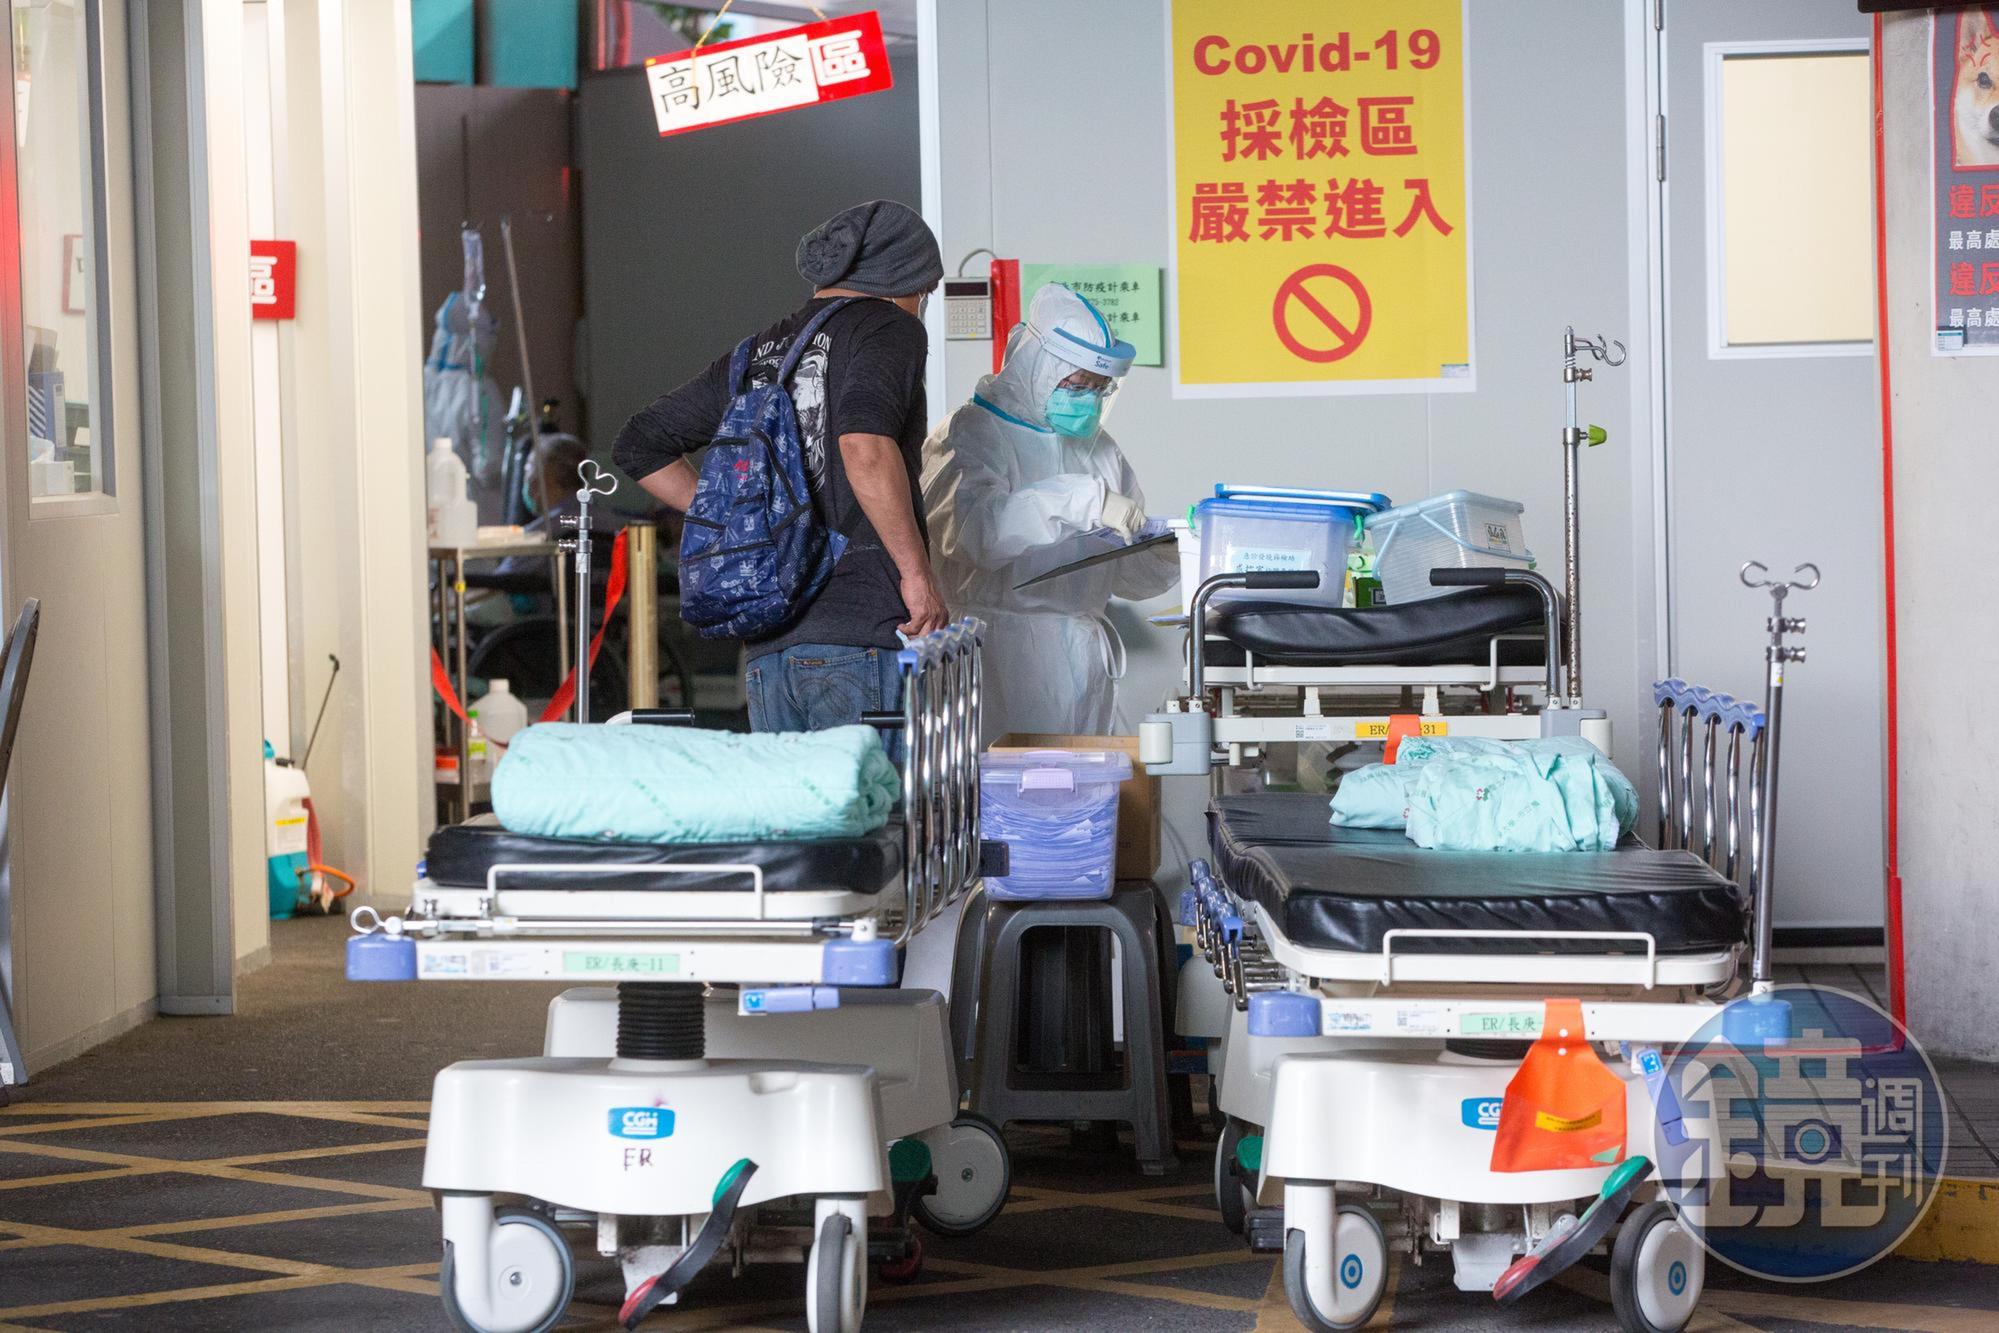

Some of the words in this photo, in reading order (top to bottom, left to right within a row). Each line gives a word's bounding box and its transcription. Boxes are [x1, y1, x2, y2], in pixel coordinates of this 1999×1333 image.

[659, 29, 871, 114] 高風險區
[1193, 28, 1441, 76] Covid-19
[1220, 96, 1418, 162] 採檢區
[1188, 177, 1454, 244] 嚴禁進入
[1948, 184, 1999, 219] 違反
[1949, 262, 1999, 297] 違反
